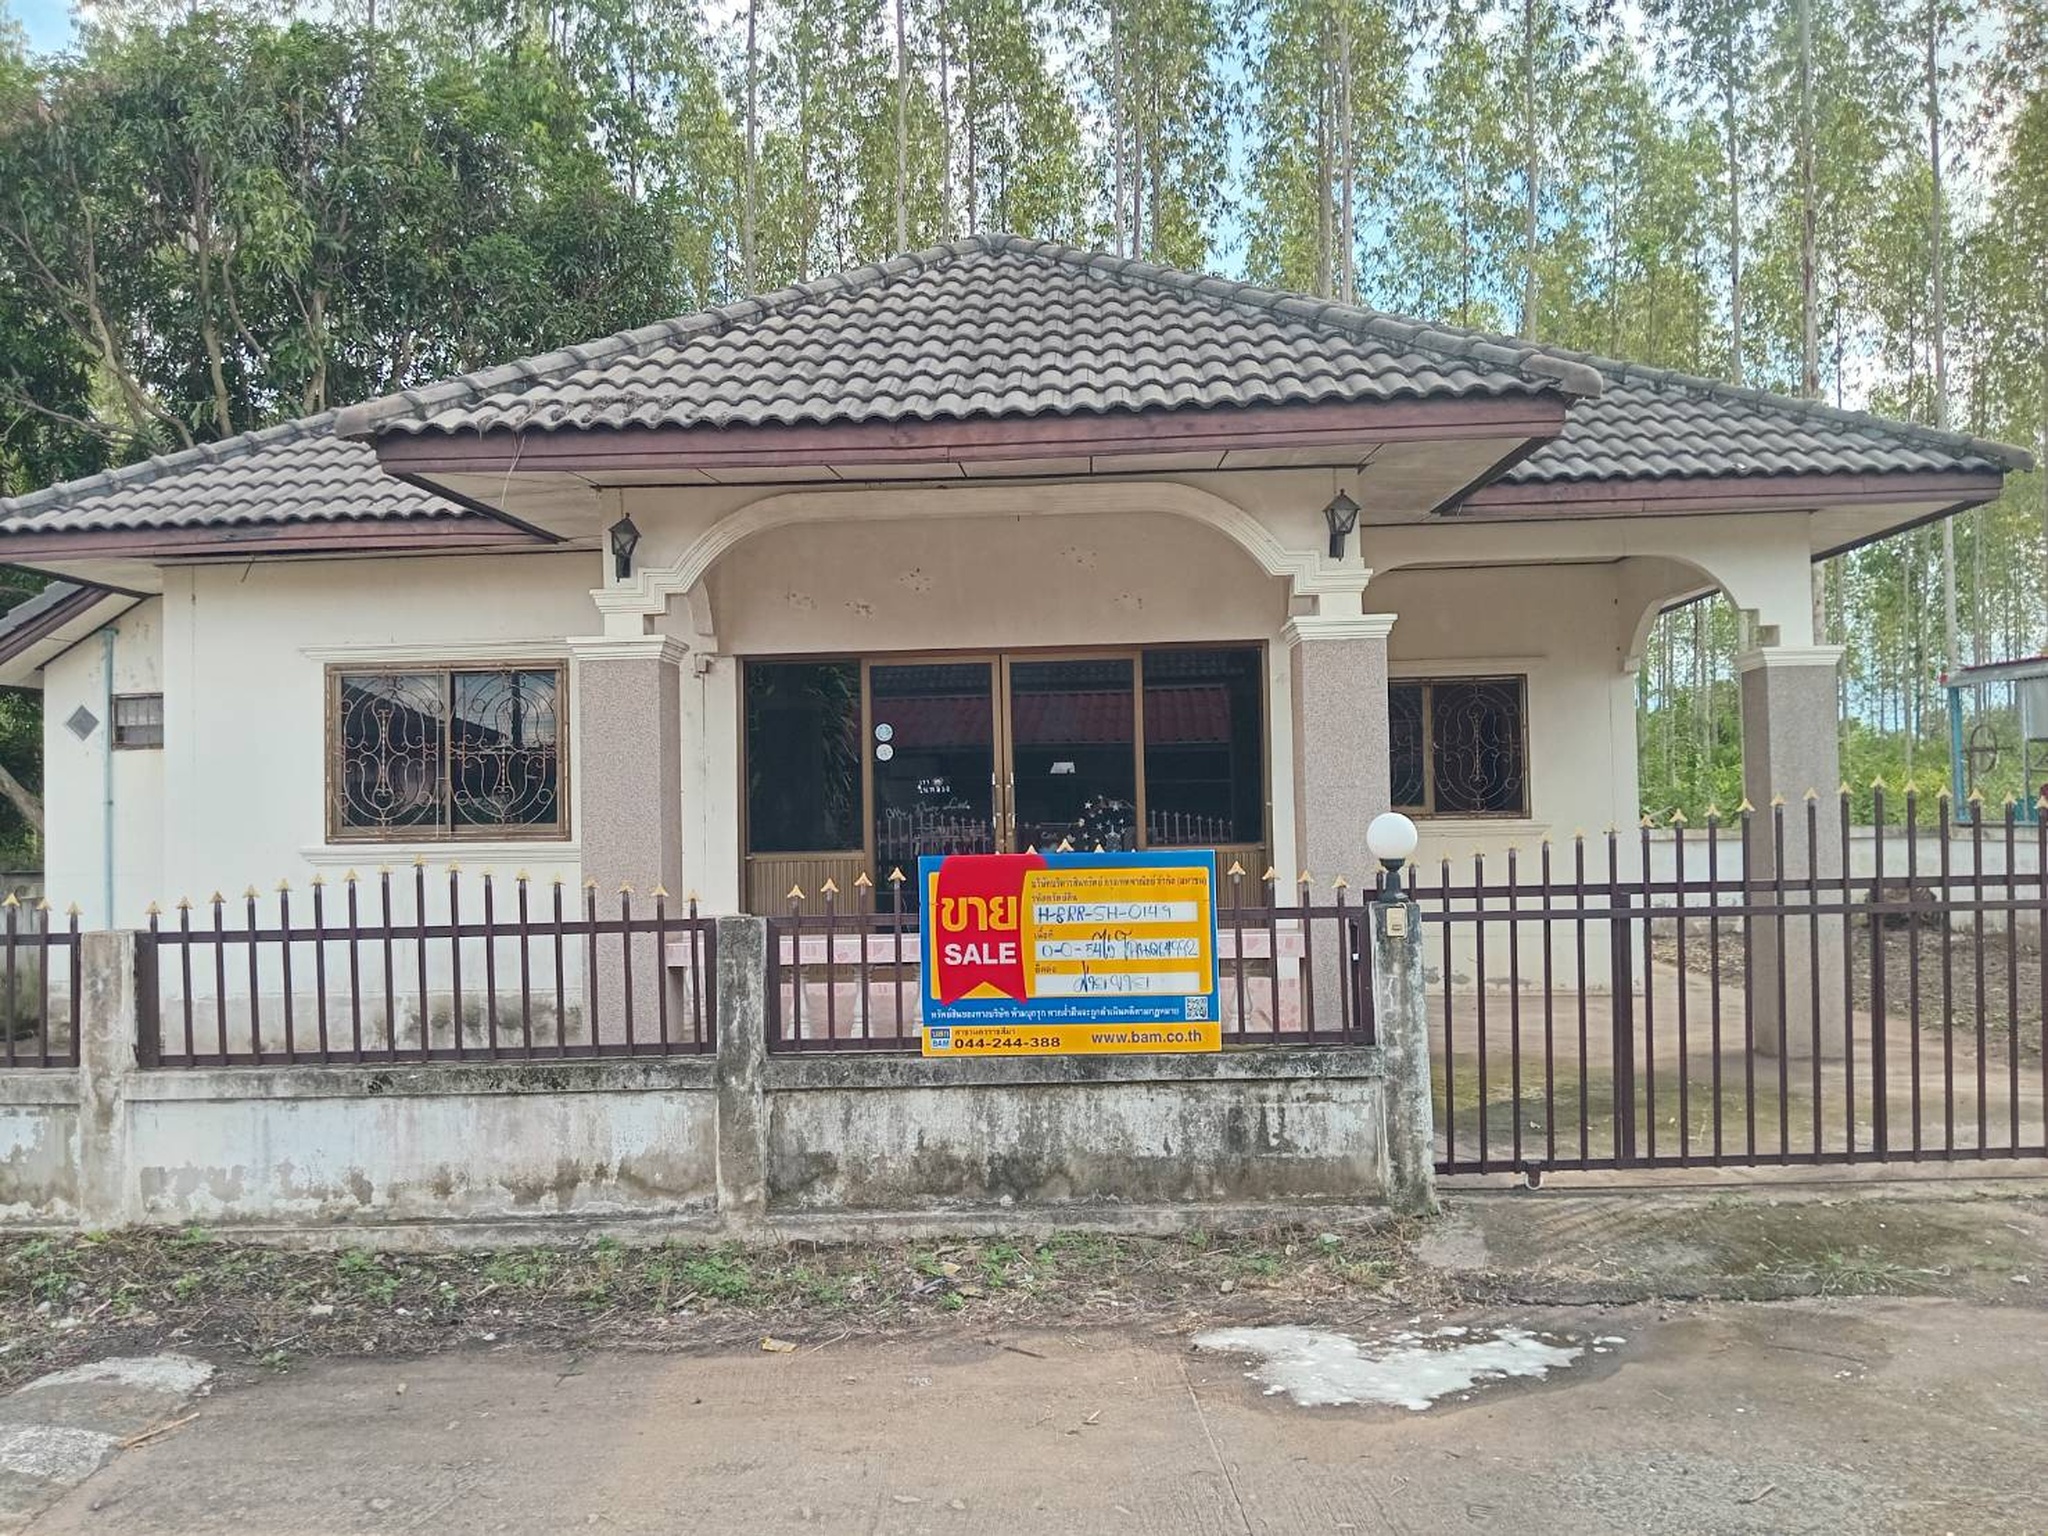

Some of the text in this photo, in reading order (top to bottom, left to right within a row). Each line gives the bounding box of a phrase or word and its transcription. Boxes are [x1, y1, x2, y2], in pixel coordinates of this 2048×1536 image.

[941, 896, 1017, 931] ขาย
[944, 942, 1017, 966] SALE
[932, 1039, 949, 1048] BAM
[954, 1037, 1061, 1049] 044-244-388
[1092, 1031, 1202, 1044] www.bam.co.th
